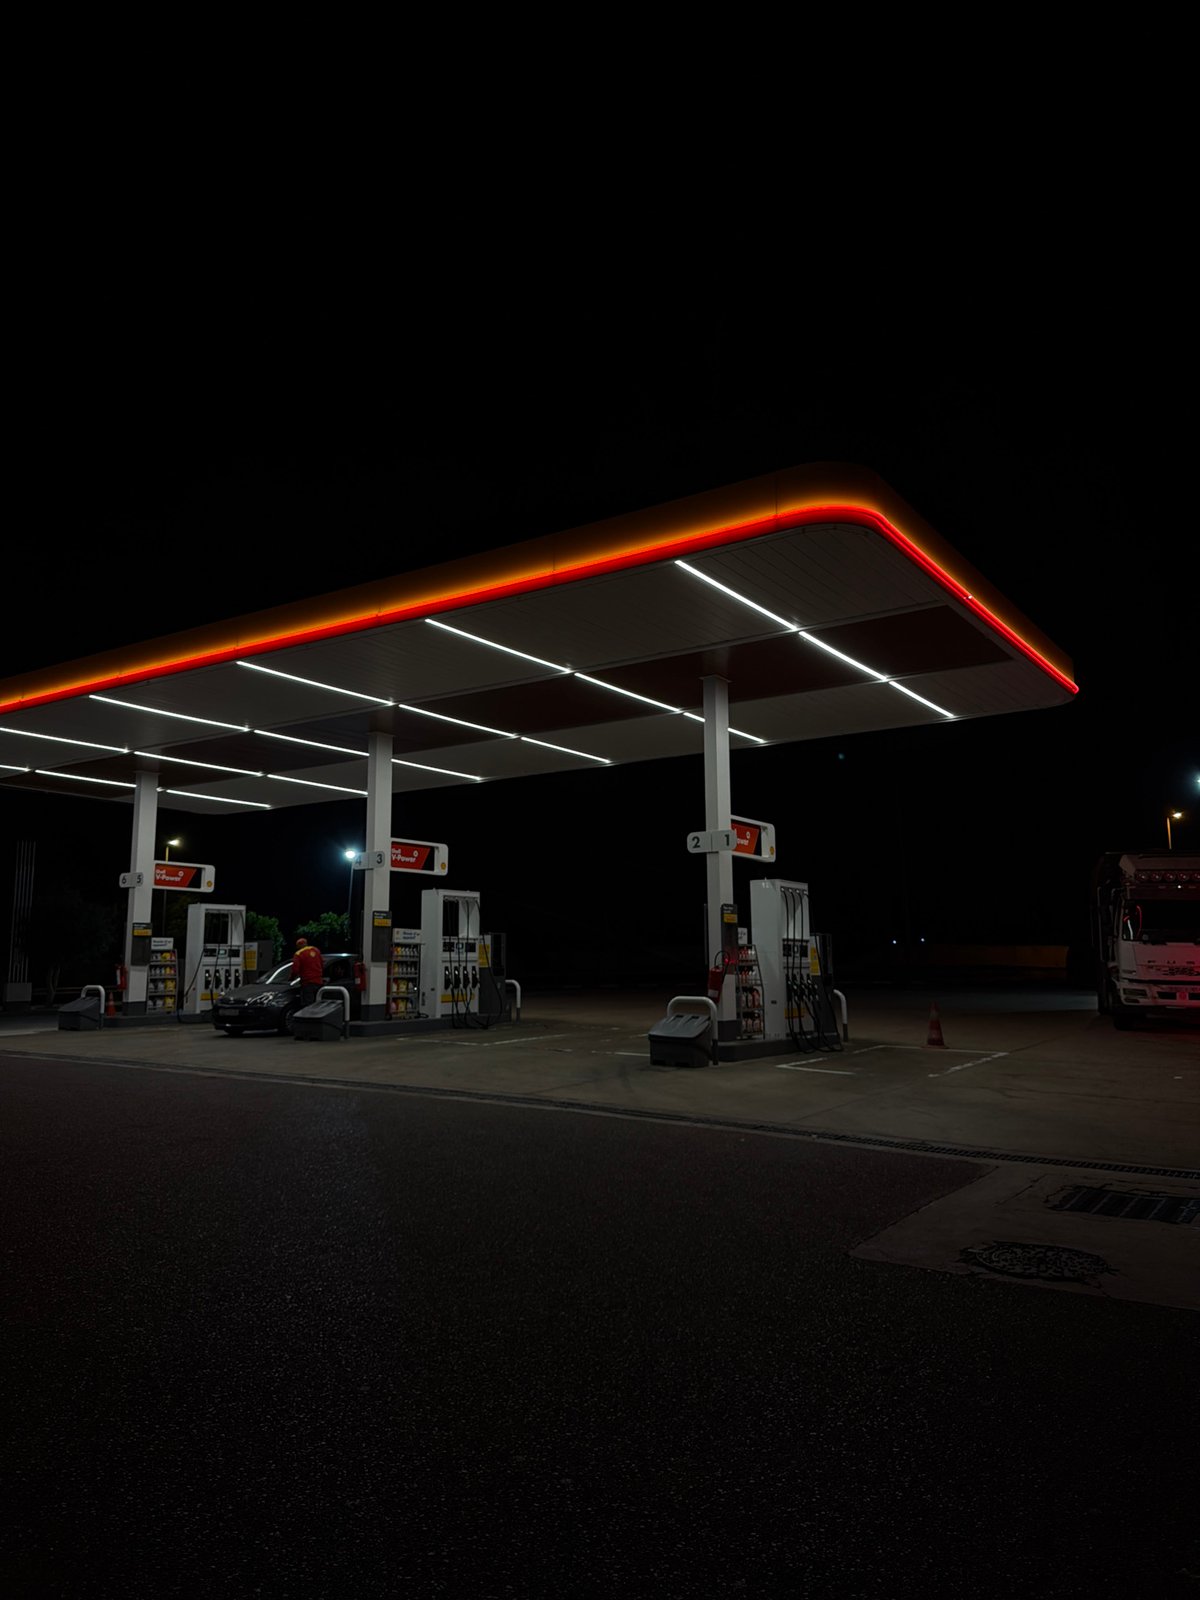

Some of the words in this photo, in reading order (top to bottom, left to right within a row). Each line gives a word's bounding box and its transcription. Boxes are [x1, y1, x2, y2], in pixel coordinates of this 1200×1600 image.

[691, 836, 701, 848] 2
[724, 834, 730, 846] 1
[376, 854, 382, 864] 3
[122, 875, 126, 884] 6
[136, 875, 141, 884] 5
